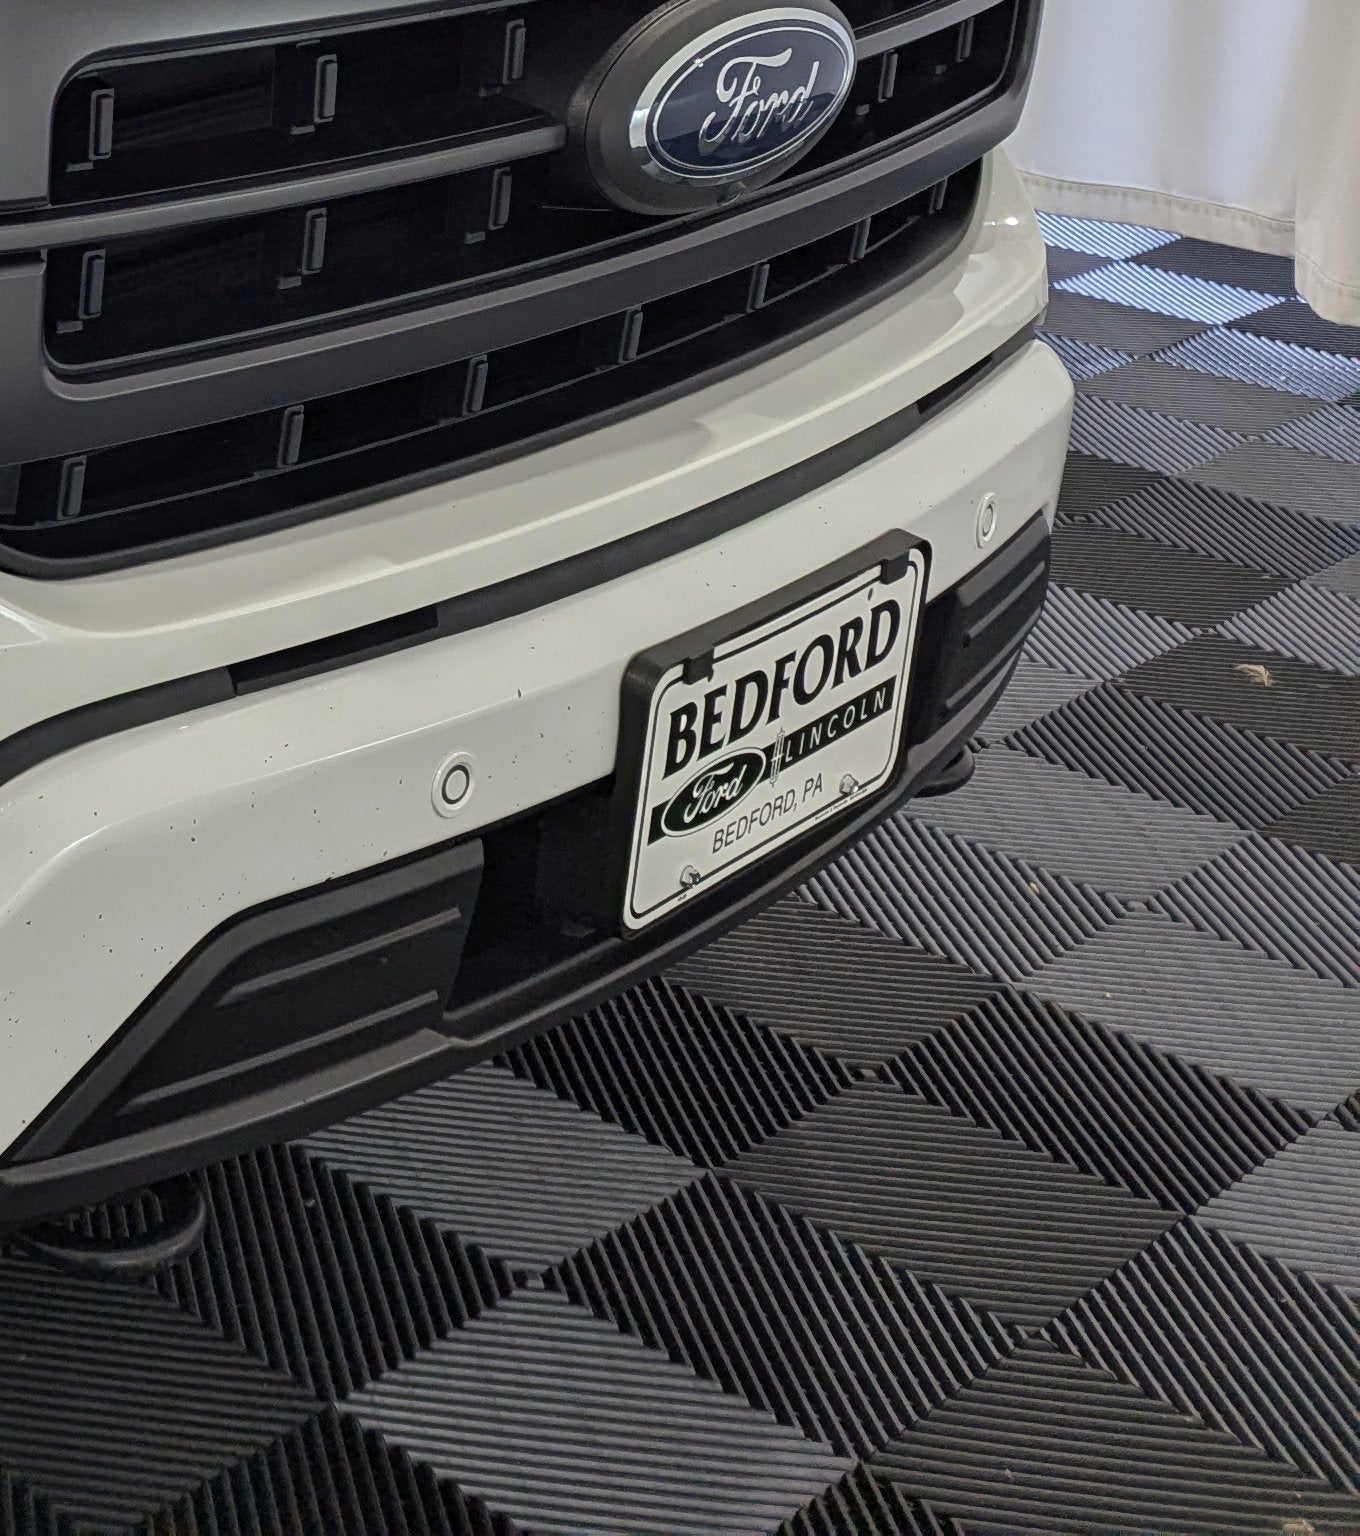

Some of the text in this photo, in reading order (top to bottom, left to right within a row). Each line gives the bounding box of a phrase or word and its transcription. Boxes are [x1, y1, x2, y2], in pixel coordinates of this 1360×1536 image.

[701, 48, 819, 143] Ford
[662, 598, 902, 780] BEDFORD
[784, 685, 888, 764] LINCOLN
[684, 761, 746, 823] Ford
[712, 788, 798, 854] BEDFORD,
[802, 772, 824, 805] PA
